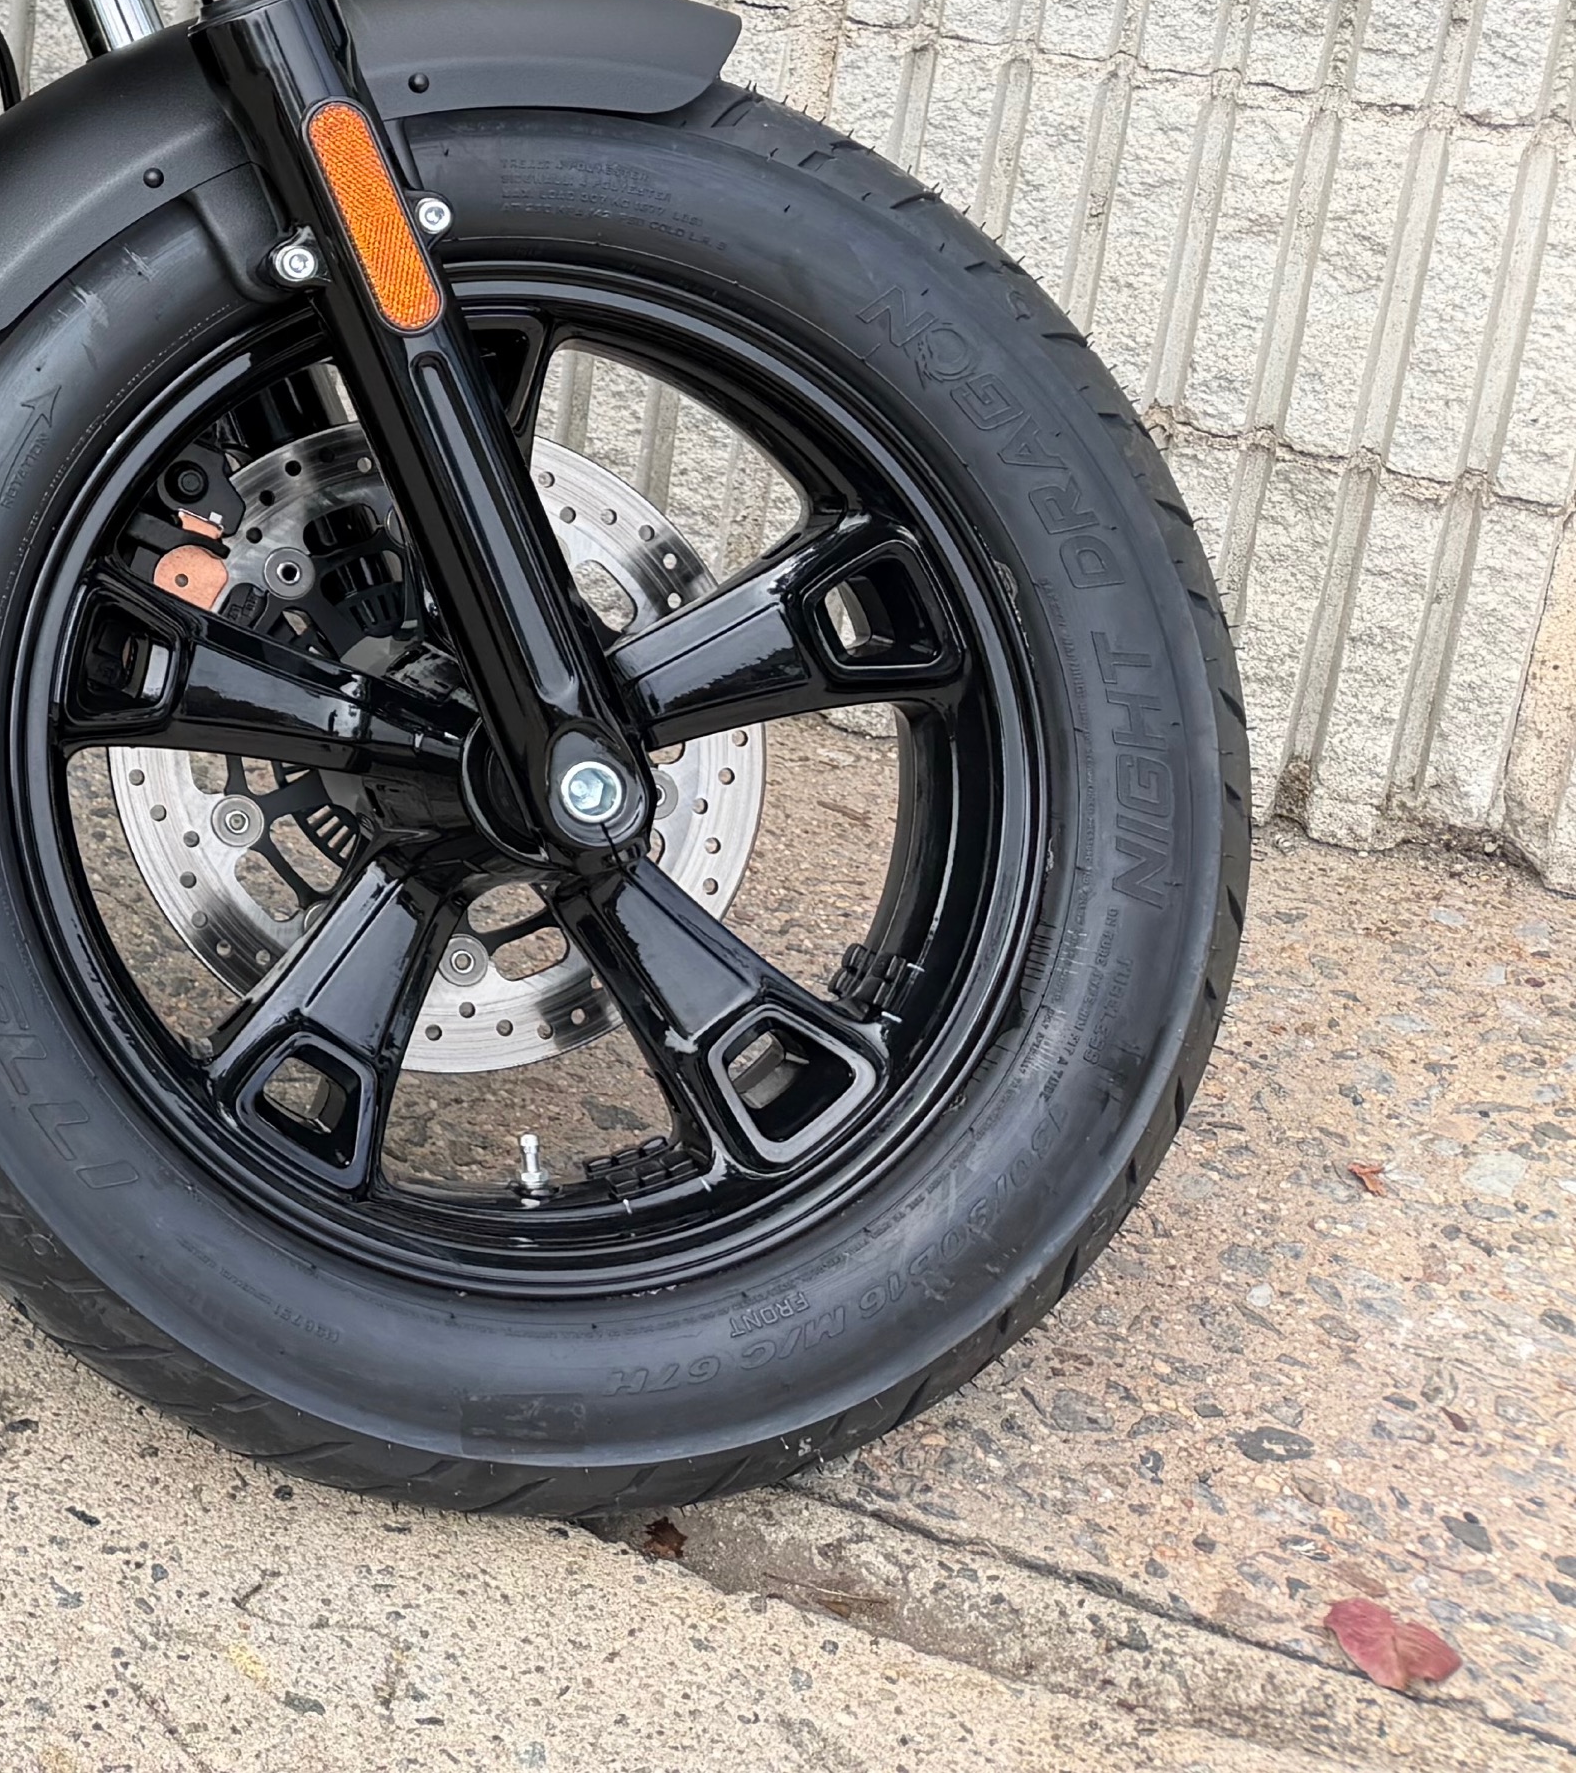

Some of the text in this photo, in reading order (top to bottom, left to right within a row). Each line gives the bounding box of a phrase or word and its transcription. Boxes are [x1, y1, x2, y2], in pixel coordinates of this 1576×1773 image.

[0, 431, 51, 510] ROTATION
[857, 283, 1175, 911] NIGHT DRAGON
[1082, 957, 1136, 1064] TUBELESS
[730, 1289, 810, 1338] FRONT
[739, 1303, 849, 1372] M/C
[602, 1352, 722, 1398] 67H
